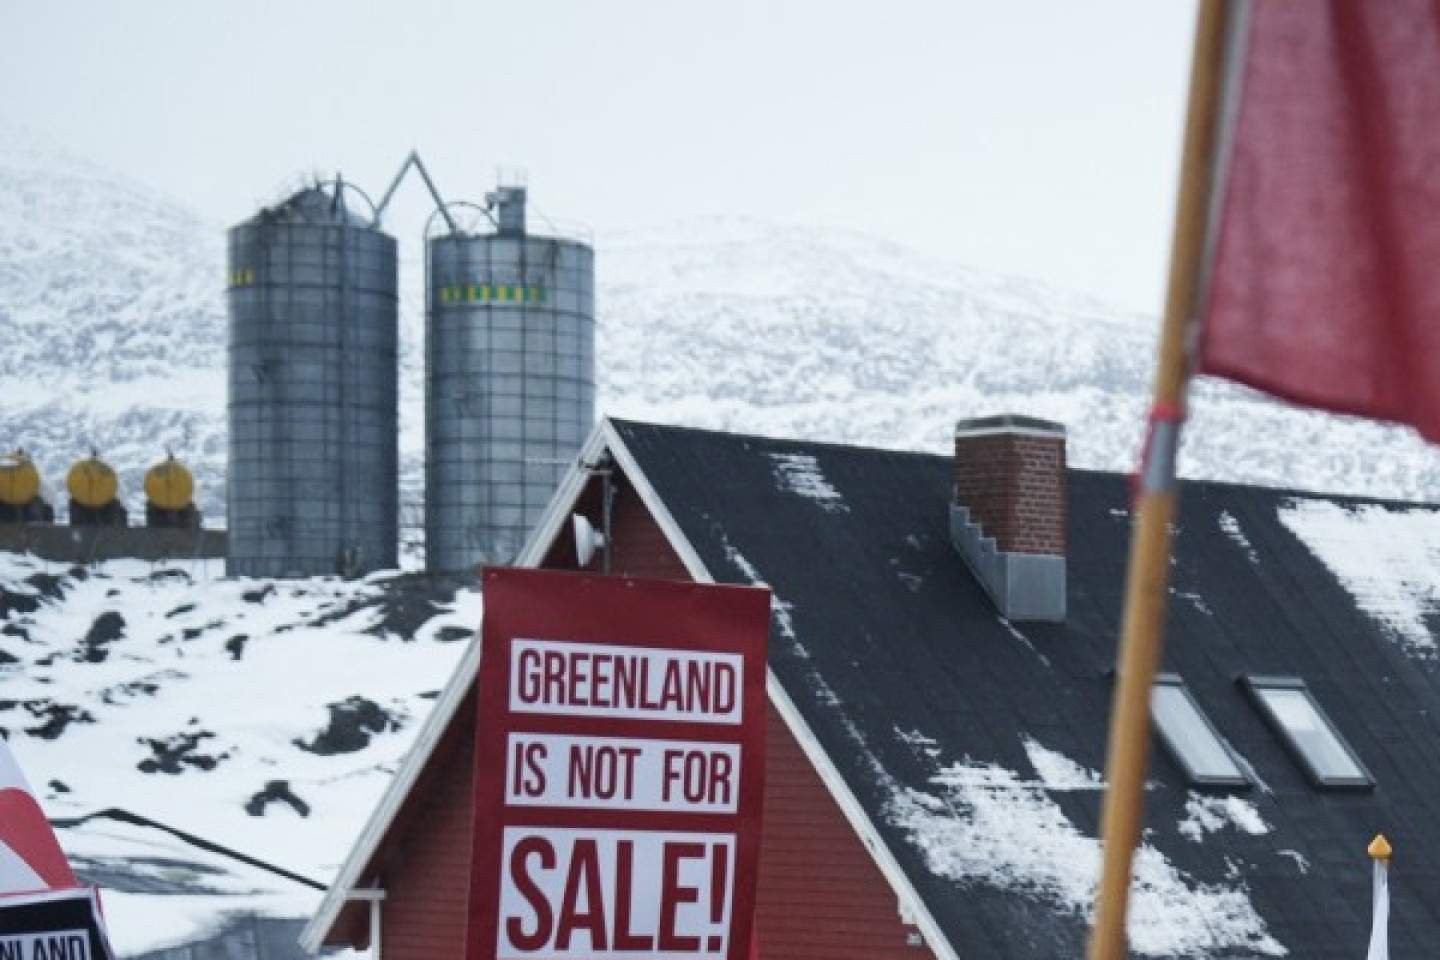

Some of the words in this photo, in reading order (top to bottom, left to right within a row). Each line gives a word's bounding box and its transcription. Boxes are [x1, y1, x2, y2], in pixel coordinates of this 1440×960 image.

[517, 648, 736, 715] GREENLAND
[512, 742, 548, 798] IS
[568, 745, 642, 800] NOT
[661, 750, 733, 805] FOR
[505, 834, 729, 953] SALE!
